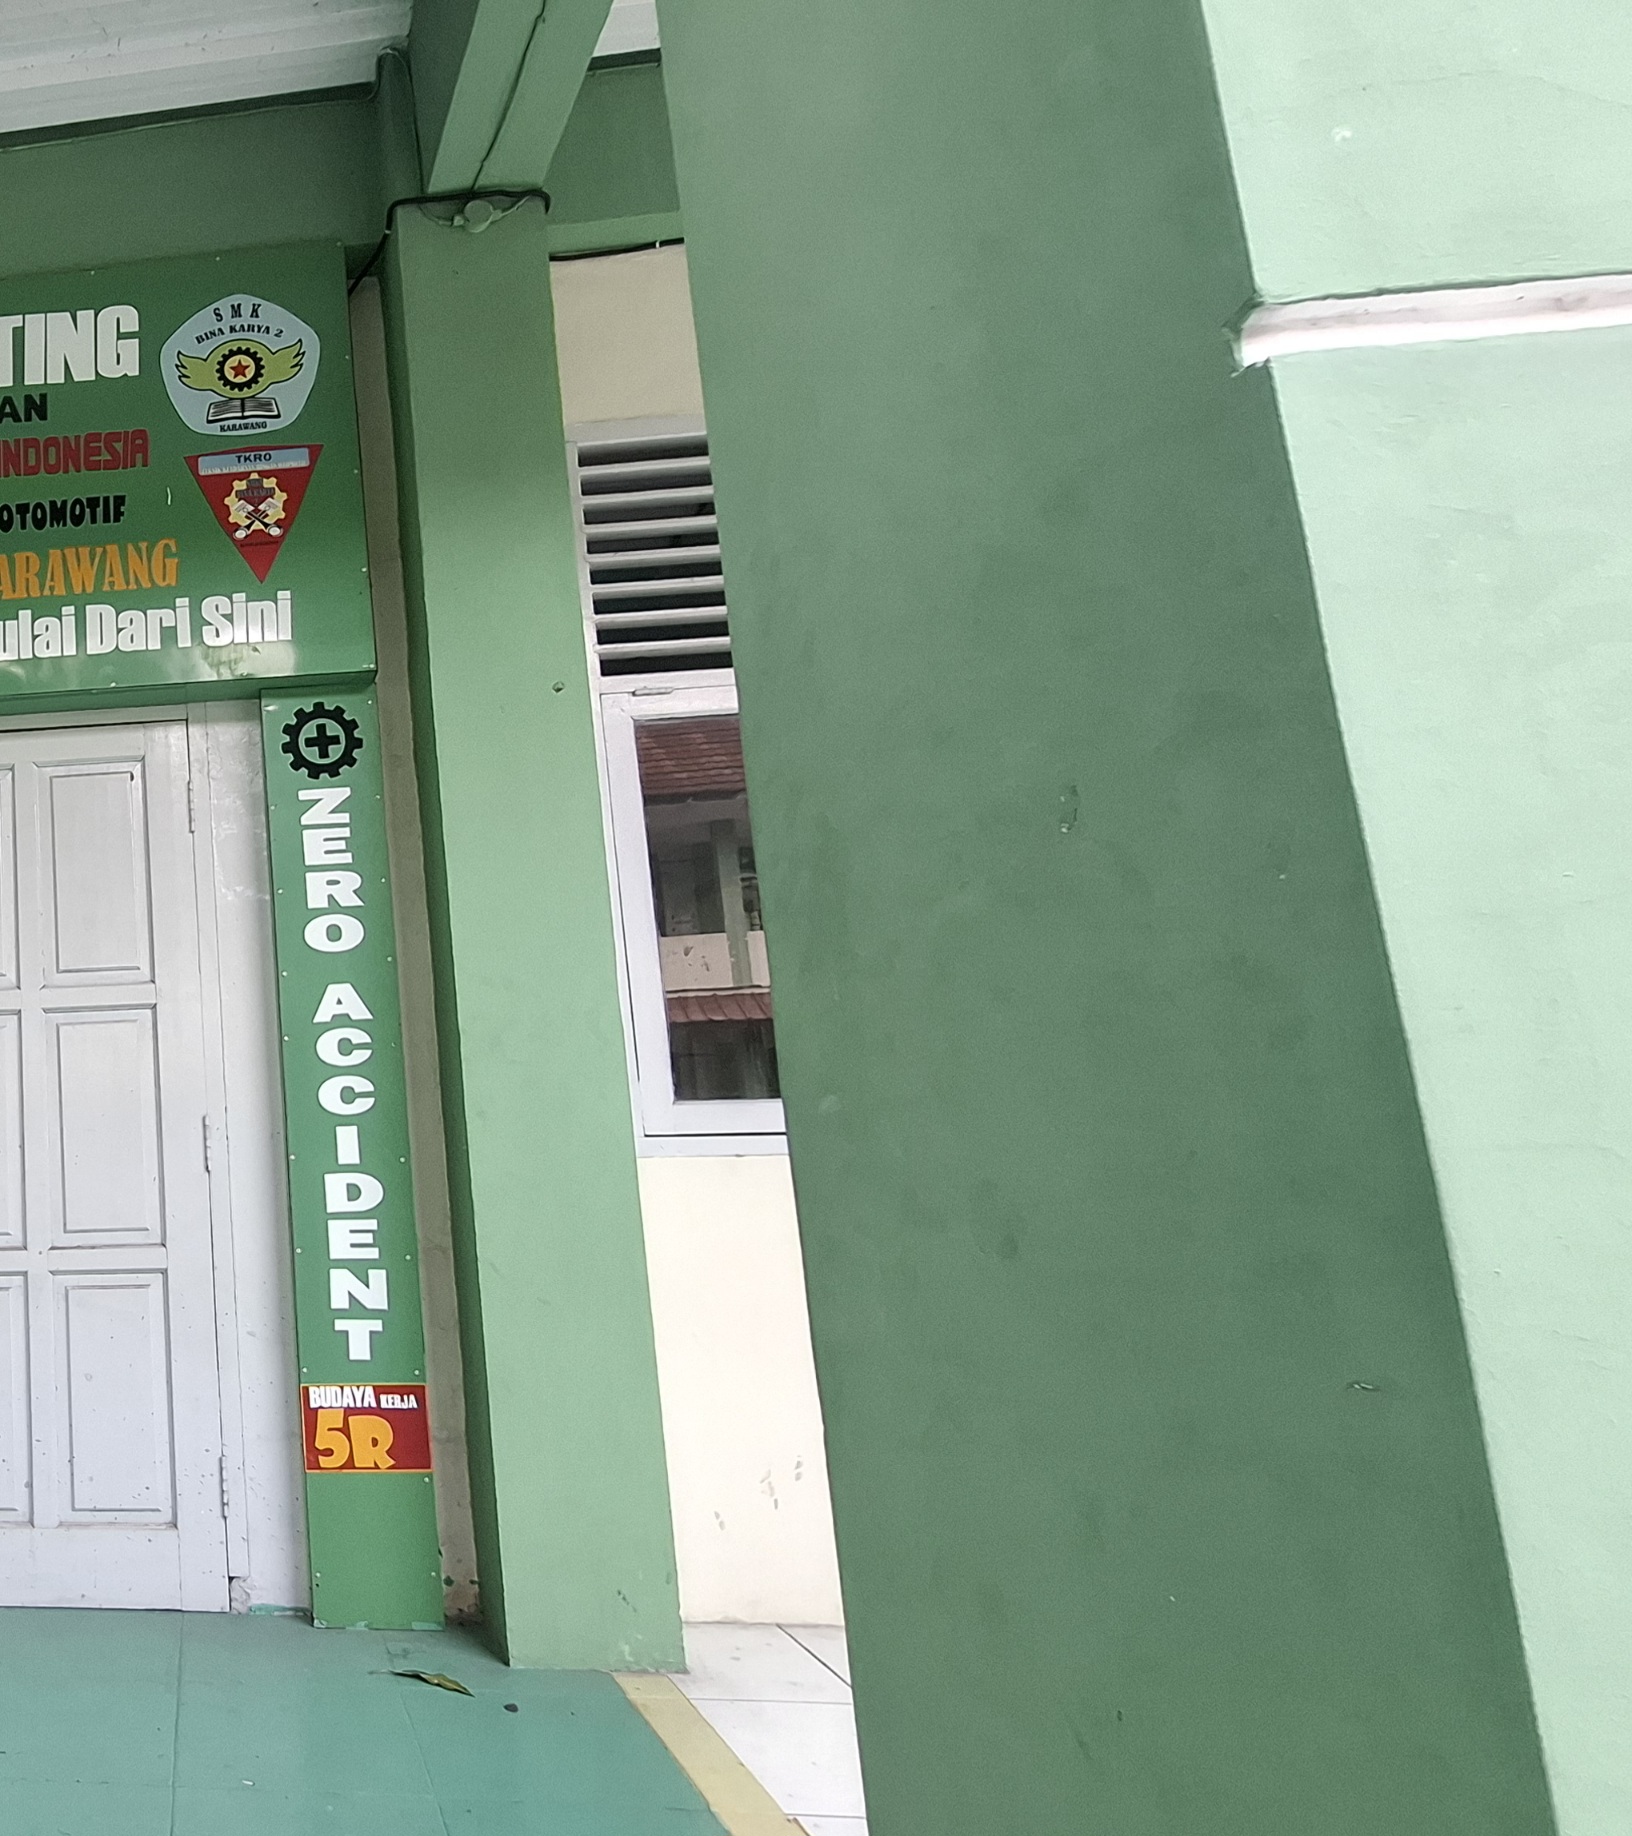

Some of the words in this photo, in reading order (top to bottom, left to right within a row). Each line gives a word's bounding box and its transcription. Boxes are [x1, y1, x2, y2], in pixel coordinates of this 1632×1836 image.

[195, 327, 225, 345] BINA
[229, 323, 270, 336] KARYA
[274, 328, 284, 338] 2
[219, 421, 267, 432] KARAWANG
[235, 452, 272, 464] TKRO
[85, 597, 192, 655] Dari
[200, 590, 292, 648] Sini
[297, 786, 365, 952] ZERO
[312, 983, 388, 1361] ACCIDENT
[308, 1386, 377, 1409] BUDAYA
[380, 1394, 418, 1409] KERJA
[315, 1408, 396, 1469] 5R
